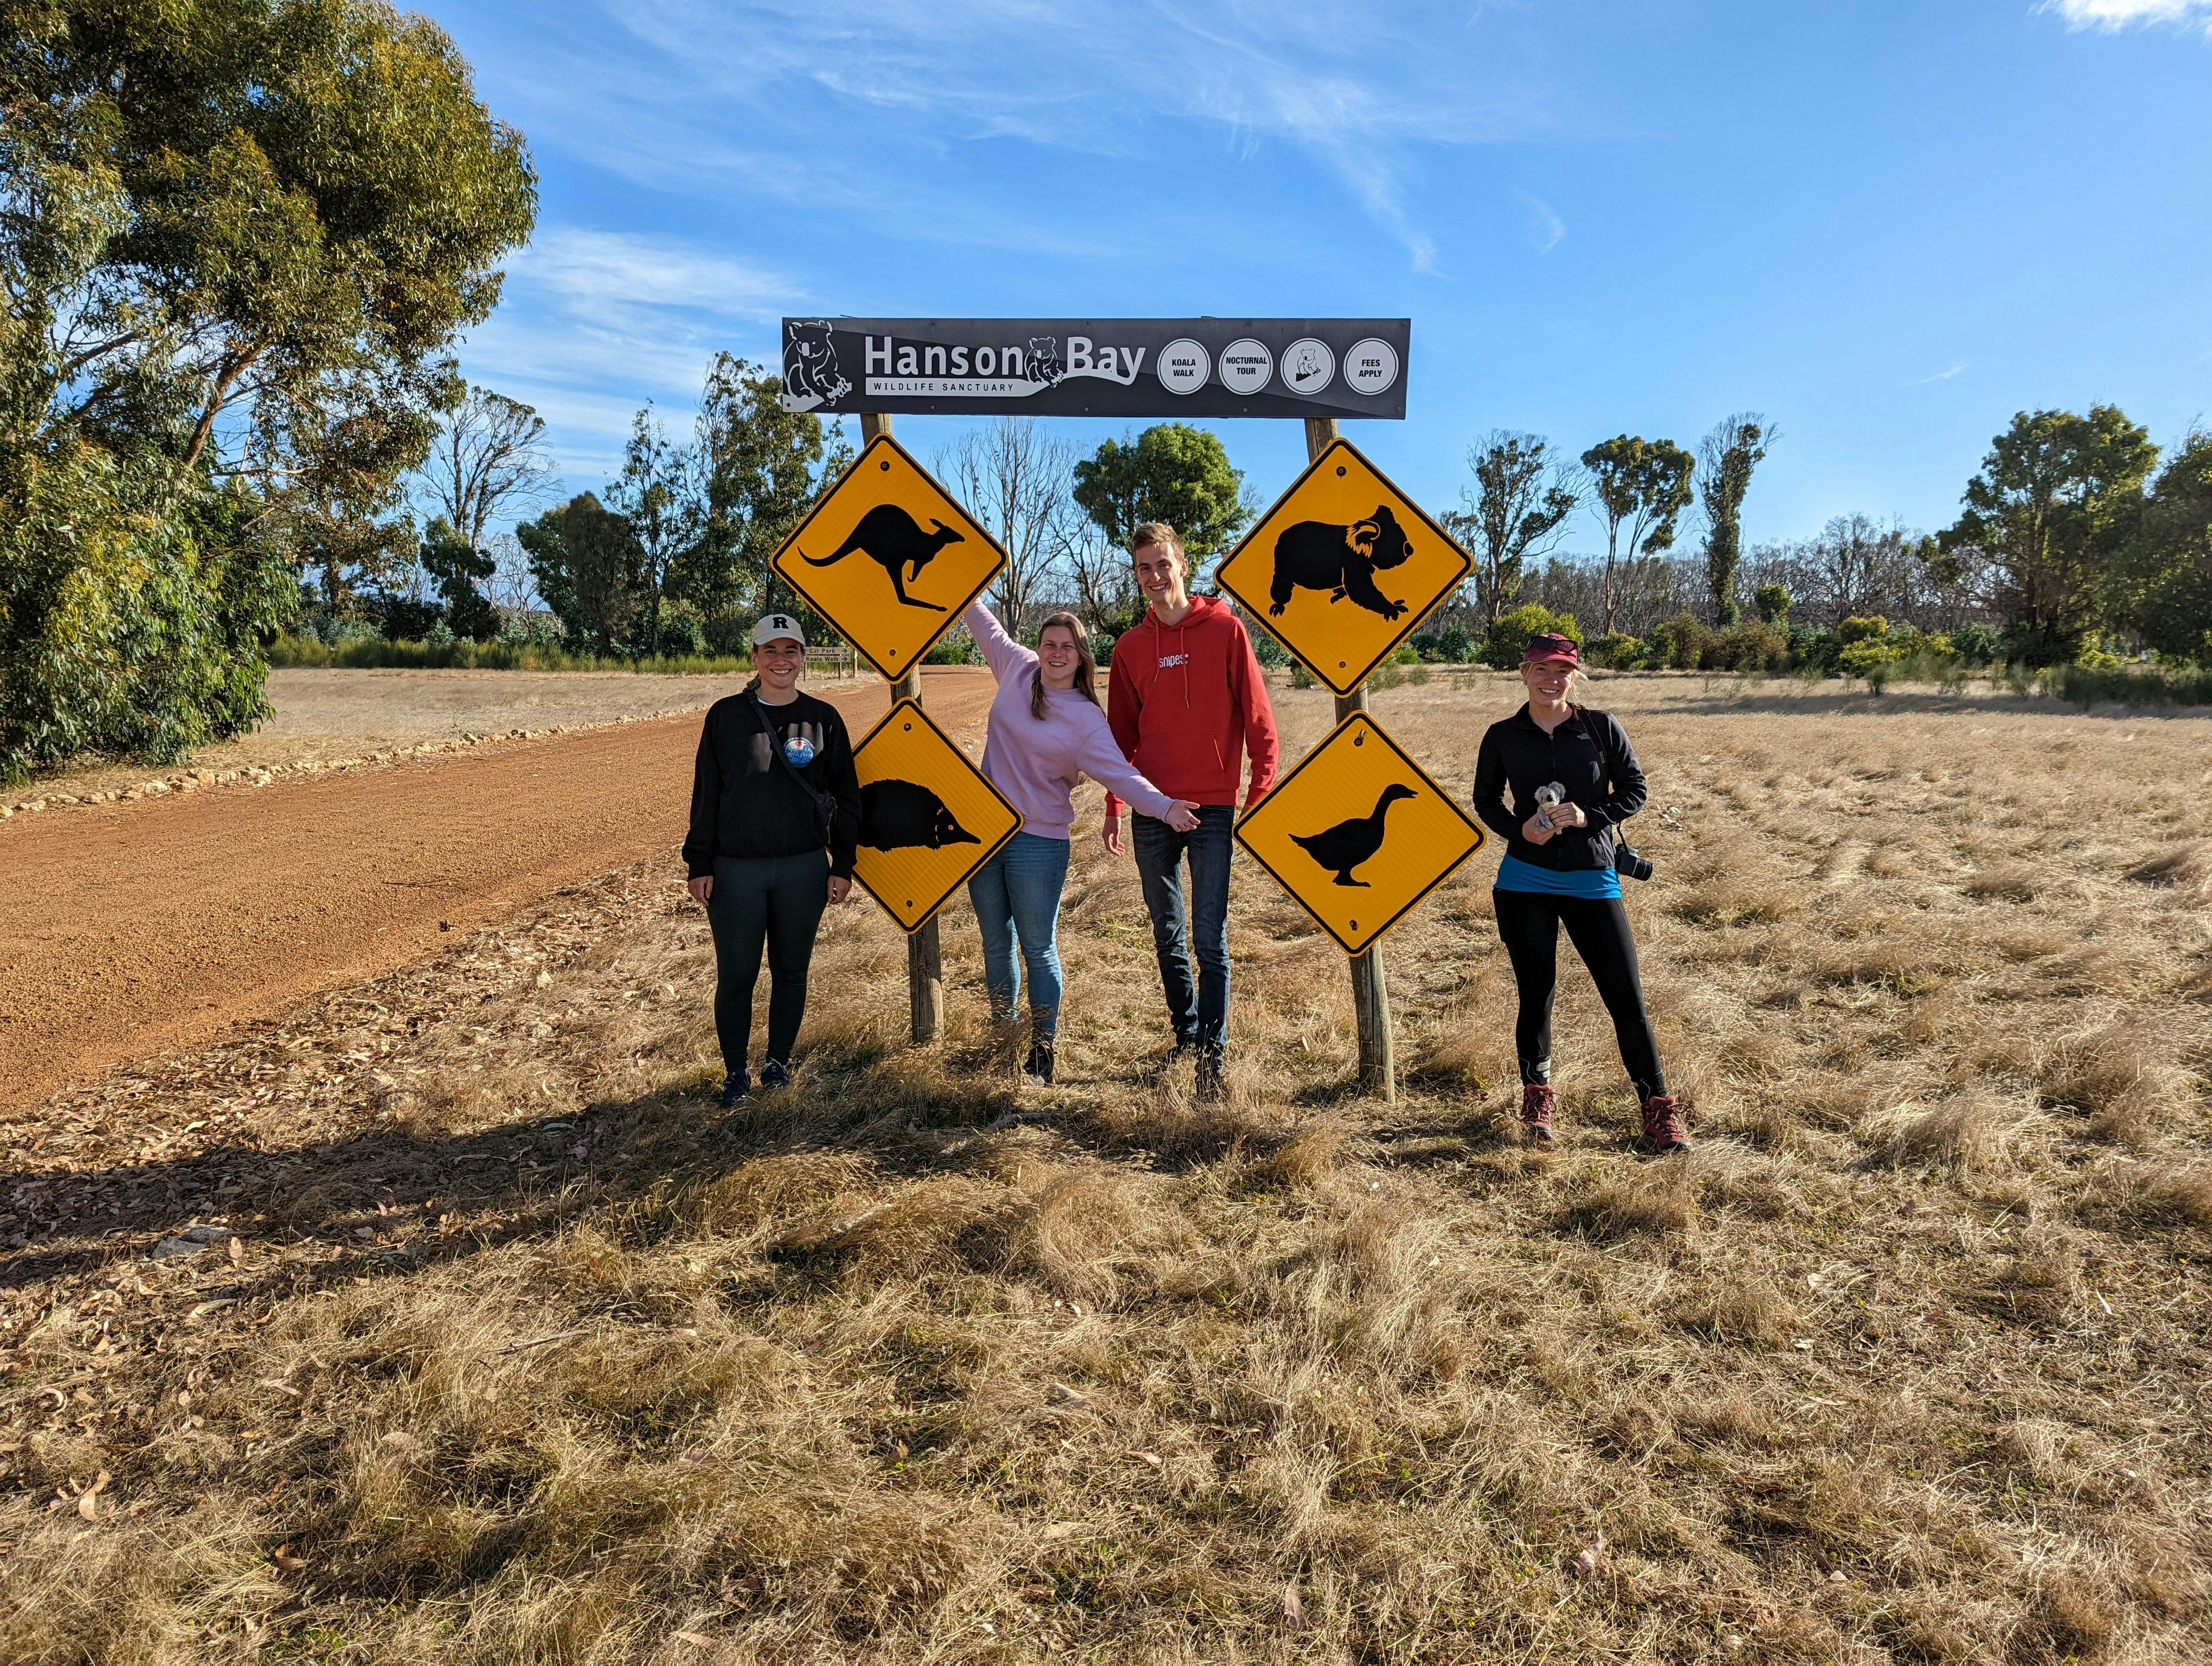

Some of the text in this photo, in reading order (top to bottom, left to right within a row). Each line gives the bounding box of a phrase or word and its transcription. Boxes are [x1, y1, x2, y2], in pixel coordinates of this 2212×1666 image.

[865, 336, 1146, 386] Hanson Bay
[1172, 358, 1196, 367] KOALA
[1237, 367, 1256, 375] TOUR
[1359, 369, 1382, 377] APPLY
[873, 382, 1013, 391] WILDLIFE SANCTUARY
[772, 617, 789, 629] R
